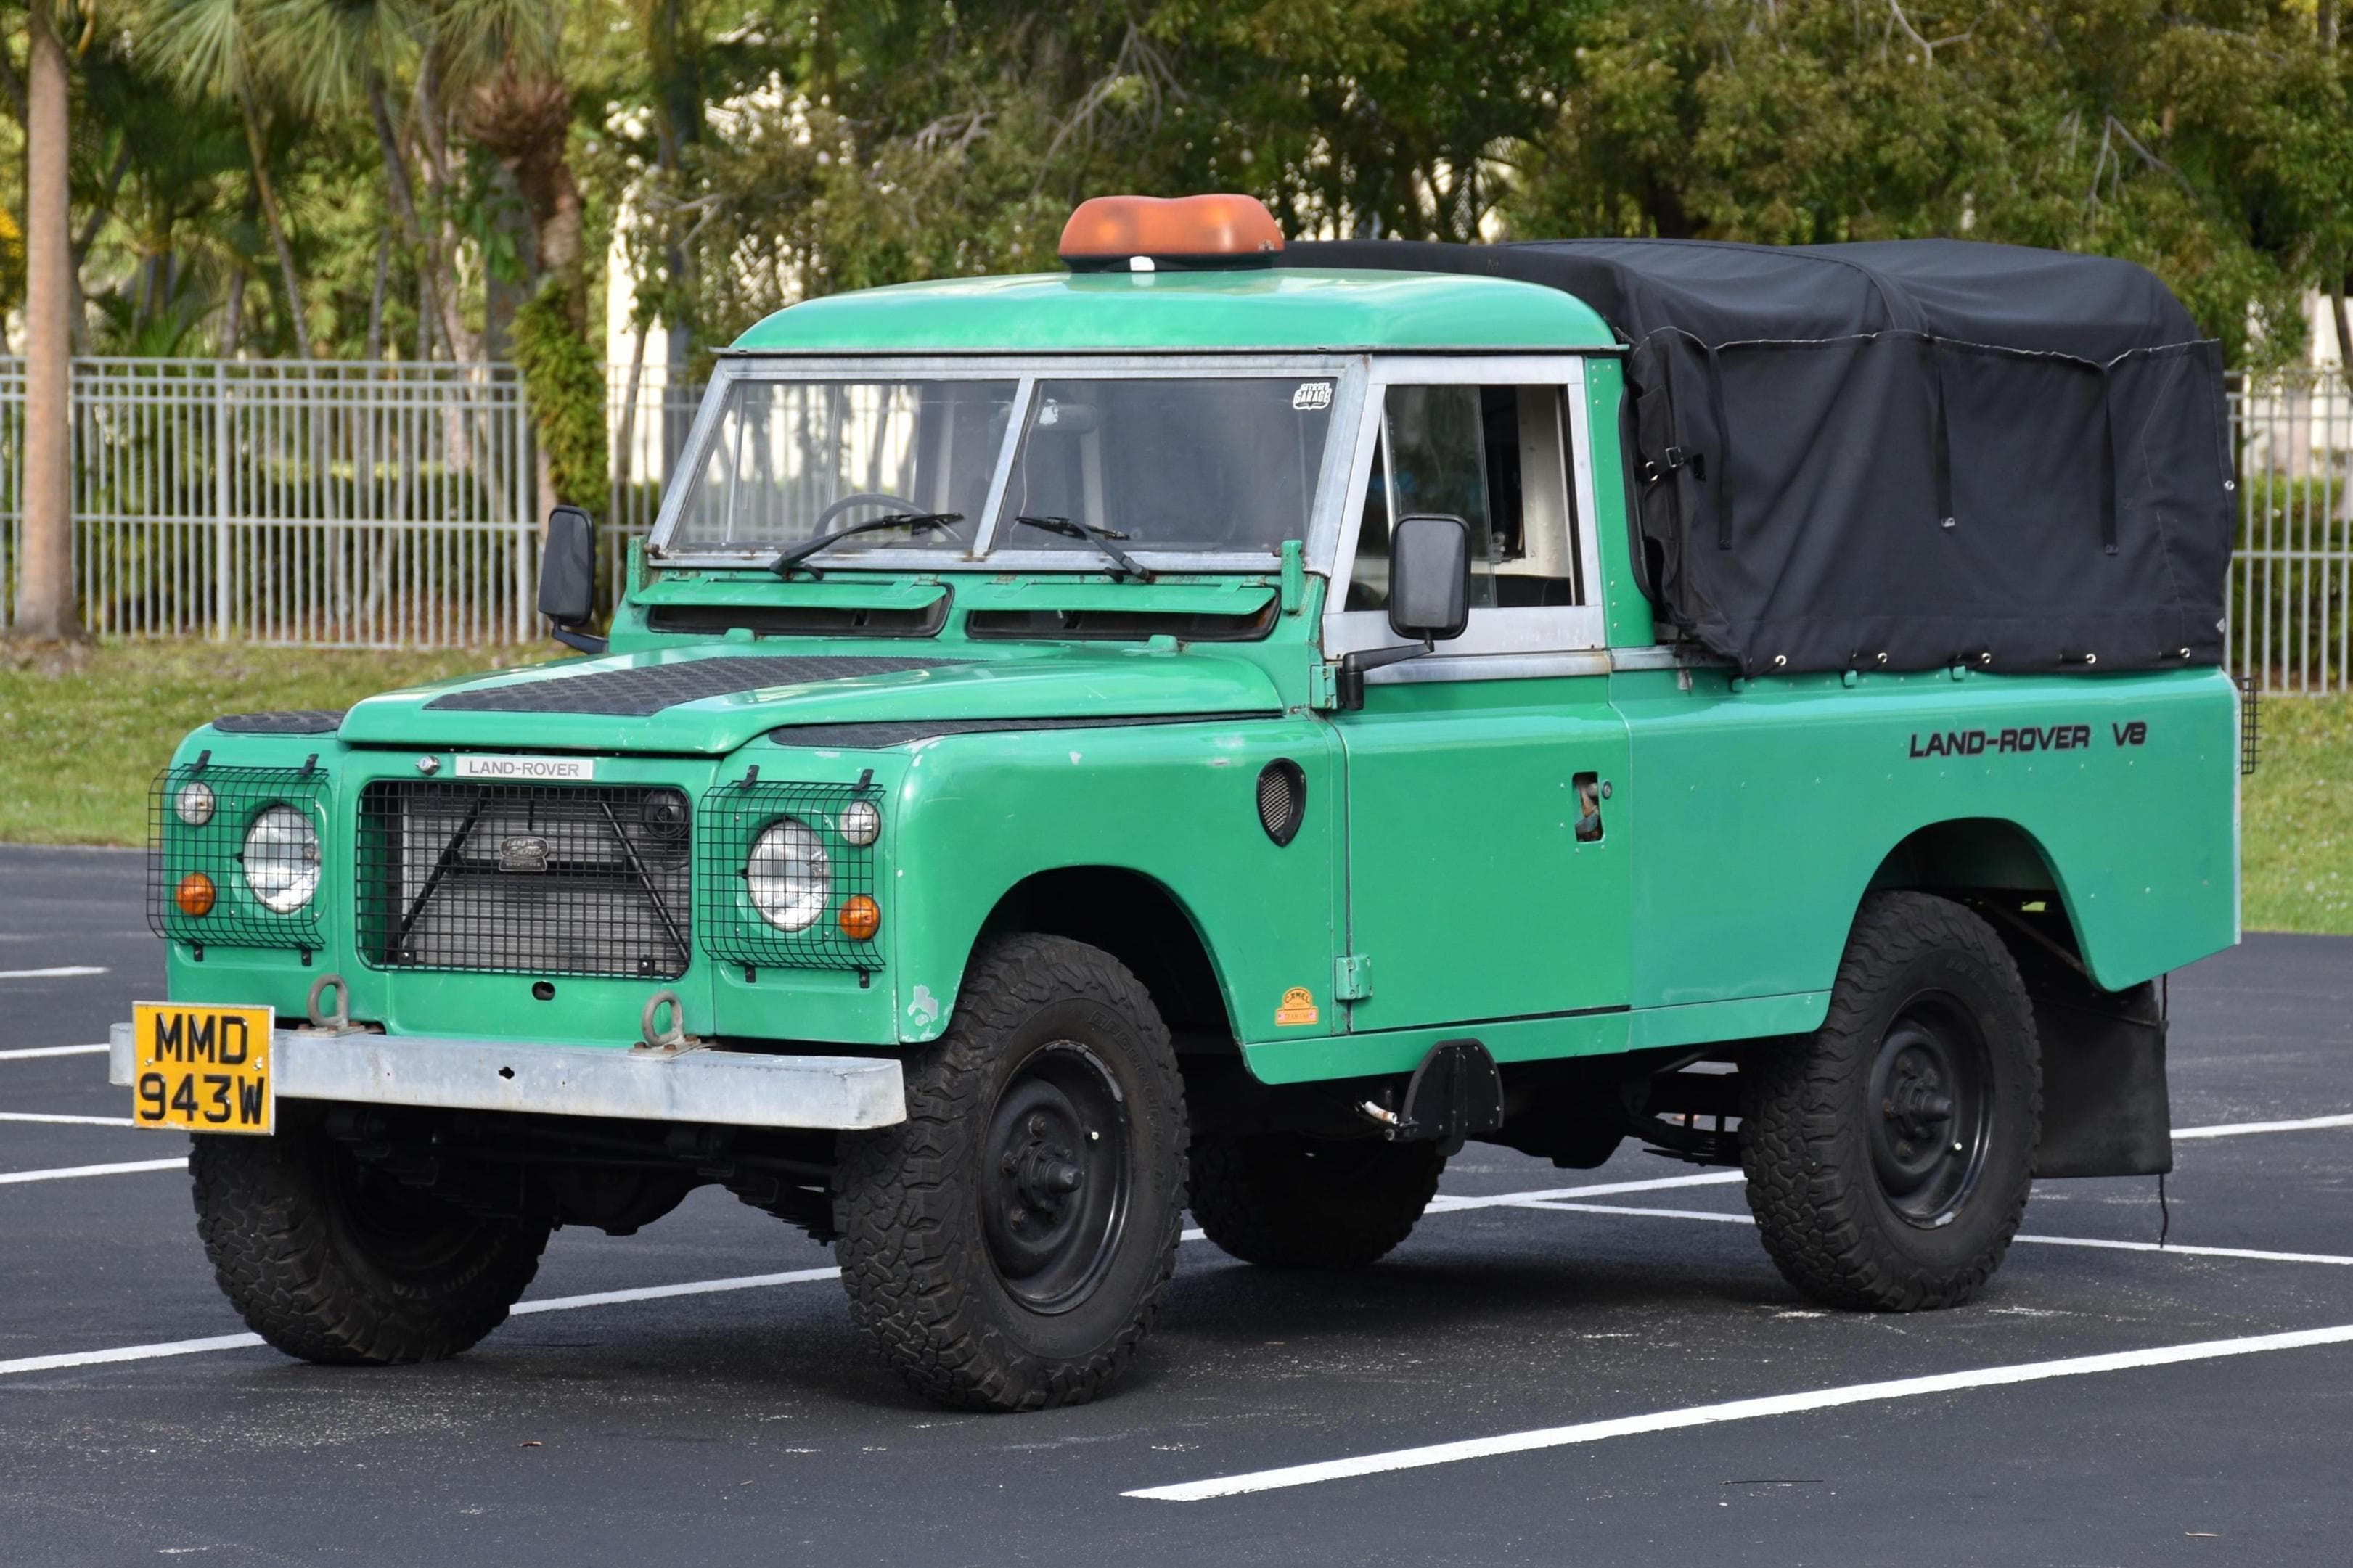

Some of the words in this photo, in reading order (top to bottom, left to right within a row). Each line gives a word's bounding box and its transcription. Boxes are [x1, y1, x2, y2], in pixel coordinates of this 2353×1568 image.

[1295, 390, 1330, 403] GARAGE
[1909, 724, 2091, 758] LAND-ROVER
[2113, 721, 2147, 747] V8
[469, 760, 580, 777] LAND-ROVER
[1285, 992, 1310, 1003] CAMEL
[155, 1012, 248, 1065] MMD
[139, 1072, 265, 1125] 943W
